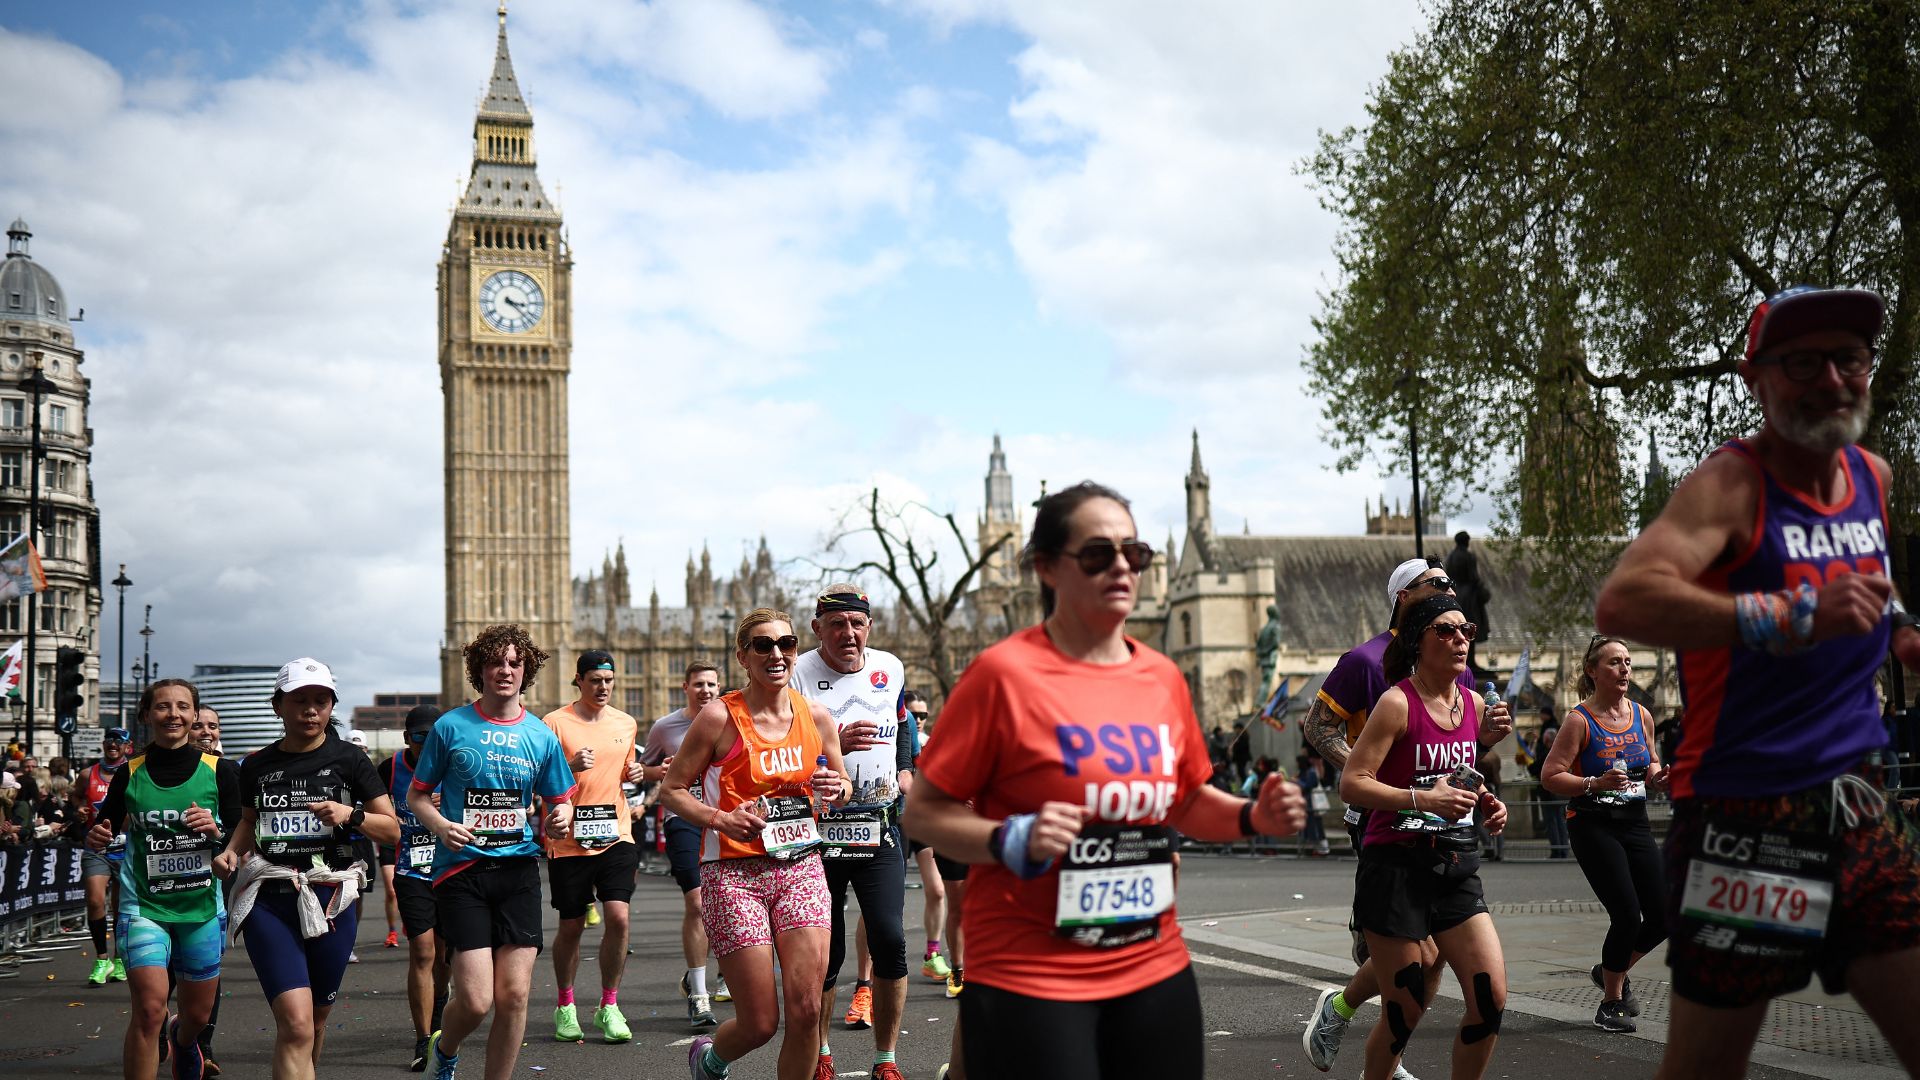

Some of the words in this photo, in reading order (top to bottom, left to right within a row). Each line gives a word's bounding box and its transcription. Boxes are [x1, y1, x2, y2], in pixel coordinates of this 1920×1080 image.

[480, 730, 519, 749] JOE
[1604, 732, 1638, 747] SUSI
[486, 750, 532, 768] Sarcoma
[760, 745, 803, 776] CARLY
[1415, 741, 1477, 770] LYNSEY
[263, 792, 288, 808] tcs
[468, 791, 490, 806] tcs
[474, 813, 516, 829] 21683
[577, 808, 594, 819] tcs
[271, 816, 321, 834] 60513
[582, 823, 613, 836] 55706
[771, 824, 811, 844] 19345
[827, 827, 870, 841] 60359
[412, 835, 429, 845] tcs
[1702, 823, 1755, 861] tcs
[1758, 844, 1829, 863] CONSULTANCY
[158, 855, 202, 873] 58608
[1080, 877, 1154, 913] 67548
[1706, 875, 1808, 922] 20179
